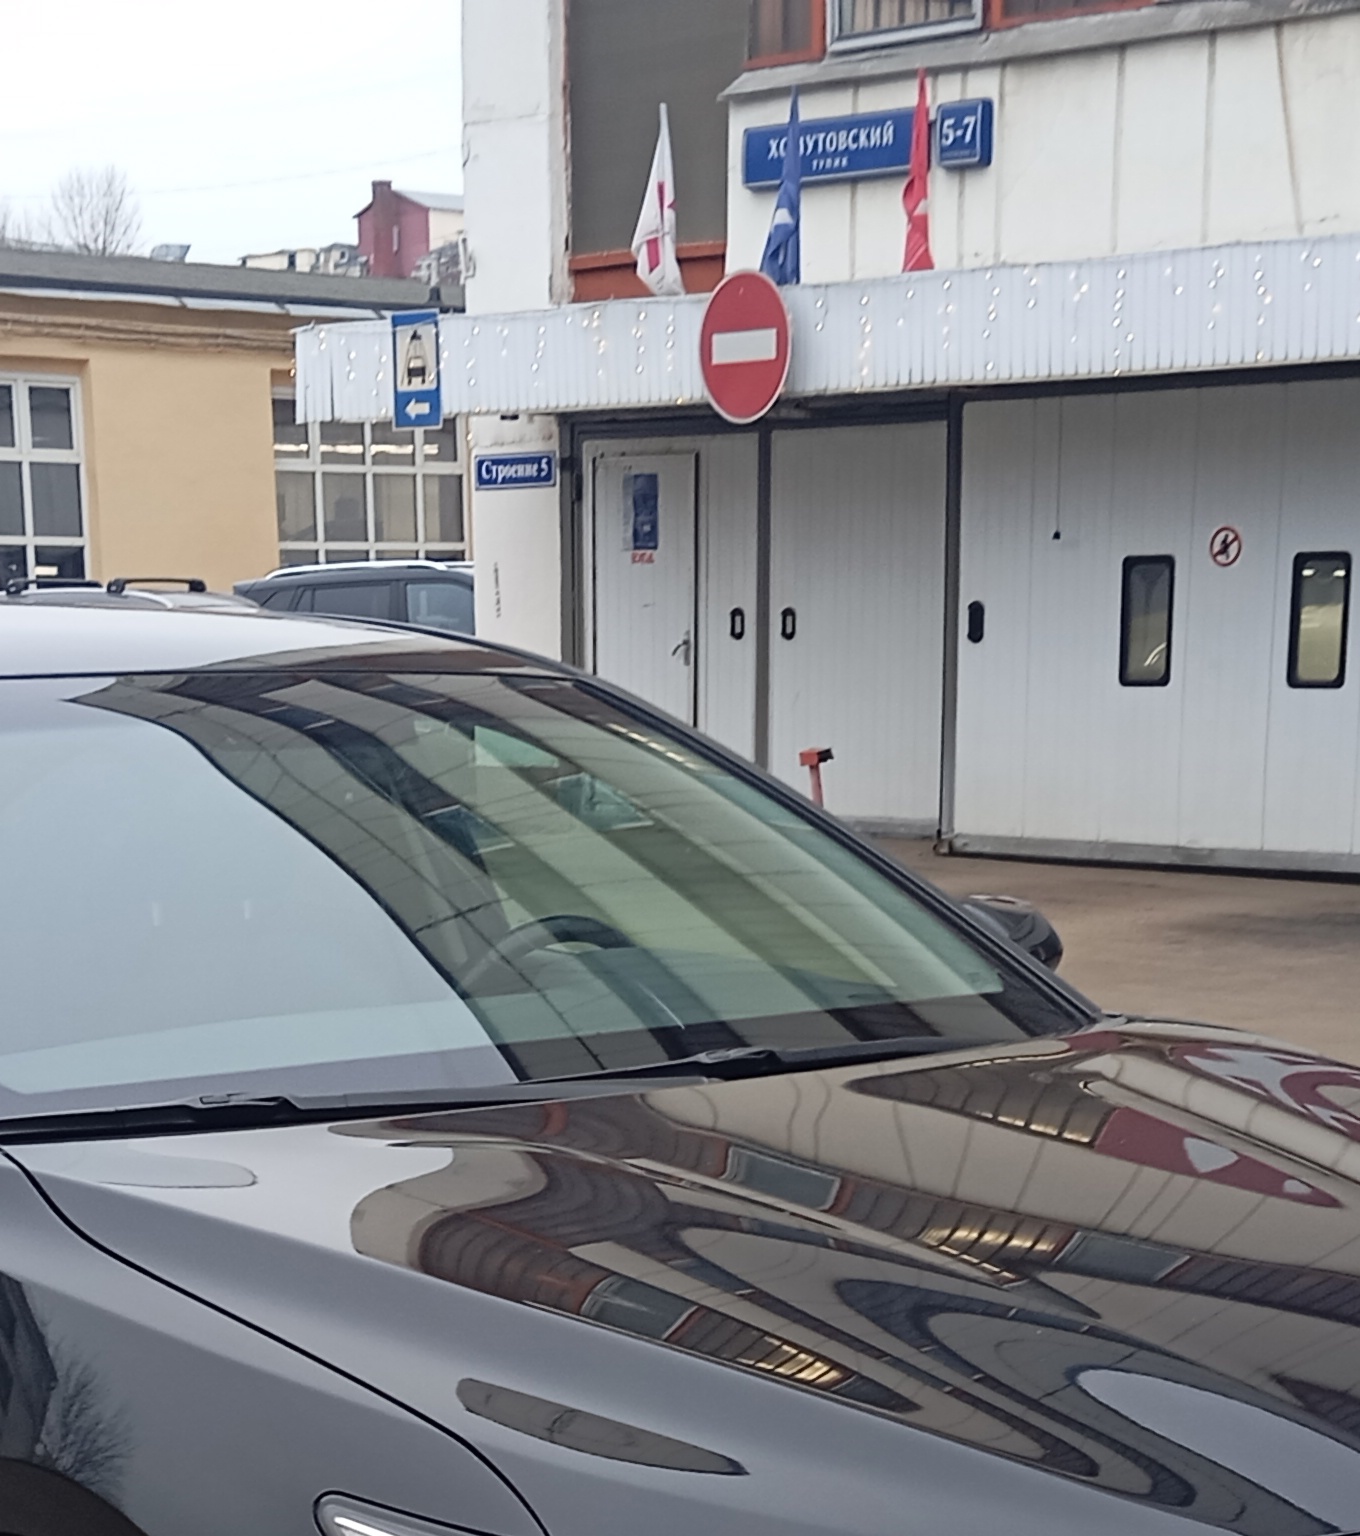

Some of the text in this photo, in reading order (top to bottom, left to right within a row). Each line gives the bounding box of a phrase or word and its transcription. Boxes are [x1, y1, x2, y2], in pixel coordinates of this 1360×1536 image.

[941, 115, 977, 147] 5-7
[811, 155, 849, 172] ТУПИК
[481, 457, 549, 484] Строение 5
